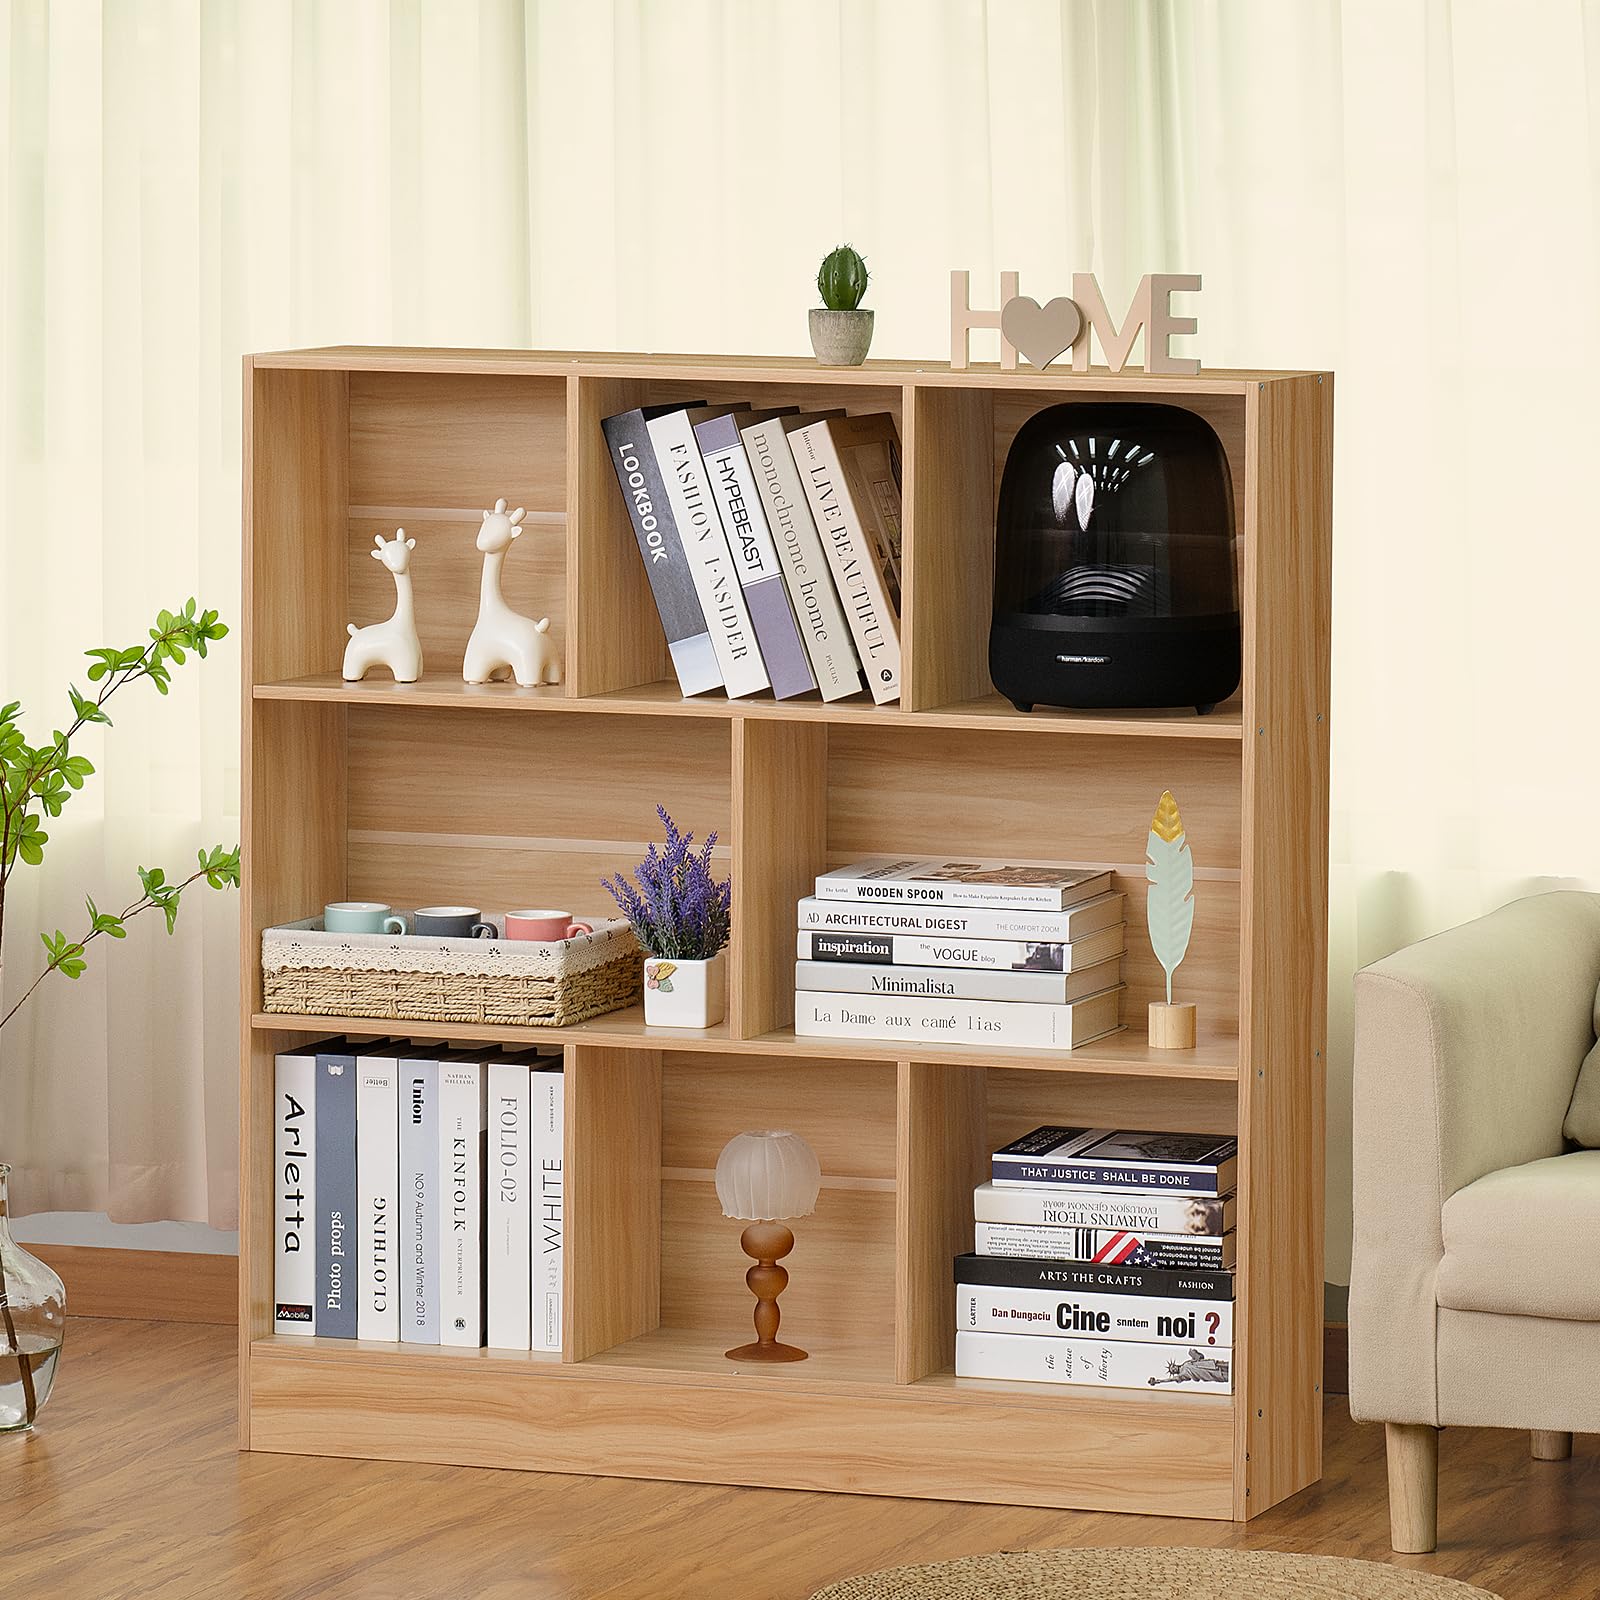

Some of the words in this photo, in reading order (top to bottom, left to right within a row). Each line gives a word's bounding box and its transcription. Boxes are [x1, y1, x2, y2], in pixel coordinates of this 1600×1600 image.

[950, 270, 1202, 375] HME
[801, 430, 817, 461] Interior
[618, 443, 668, 564] LOOKBOOK
[670, 443, 713, 542] FASHION
[716, 456, 764, 572] HYPEBEAST
[754, 432, 808, 576] monochrome
[800, 579, 828, 642] home
[810, 464, 841, 521] LIVE
[830, 525, 885, 658] BEAUTIFUL
[857, 886, 904, 898] WOODEN
[907, 888, 944, 900] SPOON
[806, 912, 820, 924] AD
[825, 914, 922, 928] ARCHITECTURAL
[926, 918, 968, 930] DIGEST
[1009, 924, 1039, 932] COMFORT
[818, 938, 890, 957] inspiration
[932, 948, 978, 962] VOGUE
[980, 954, 996, 964] blog
[871, 976, 956, 994] Minimalista
[814, 1008, 832, 1022] La
[841, 1009, 876, 1024] Dame
[885, 1014, 912, 1027] aux
[921, 1014, 956, 1029] camé
[968, 1016, 1002, 1031] lias
[412, 1078, 425, 1125] Union
[500, 1097, 517, 1203] FOLIO-02
[284, 1094, 307, 1254] Arletta
[415, 1173, 424, 1198] NO.9
[453, 1138, 466, 1232] KINFOLK
[1021, 1167, 1048, 1177] THAT
[1051, 1169, 1097, 1180] JUSTICE
[1102, 1171, 1138, 1183] SHALL
[1142, 1174, 1156, 1184] BE
[1160, 1175, 1190, 1186] DONE
[415, 1201, 424, 1240] Autumn
[542, 1159, 562, 1255] WHITE
[1043, 1210, 1087, 1225] TEORI
[1067, 1201, 1109, 1212] GJENNOM
[1090, 1212, 1159, 1229] DARWINS
[1110, 1204, 1158, 1215] EVOLUSJON
[331, 1211, 345, 1258] props
[373, 1197, 387, 1312] CLOTHING
[416, 1244, 424, 1264] and
[327, 1262, 342, 1310] Photo
[416, 1267, 425, 1298] Winter
[1039, 1271, 1068, 1283] ARTS
[1072, 1272, 1095, 1284] THE
[1098, 1274, 1143, 1287] CRAFTS
[1178, 1280, 1214, 1290] FASHION
[416, 1300, 425, 1326] 2018
[991, 1308, 1009, 1319] Dan
[1010, 1309, 1051, 1324] Dungaciu
[1056, 1303, 1111, 1333] Cine
[1116, 1318, 1149, 1328] snntem
[1156, 1312, 1196, 1339] noi
[1204, 1312, 1221, 1345] ?
[1044, 1354, 1055, 1370] the
[1080, 1356, 1094, 1370] of
[1097, 1348, 1113, 1381] liberty
